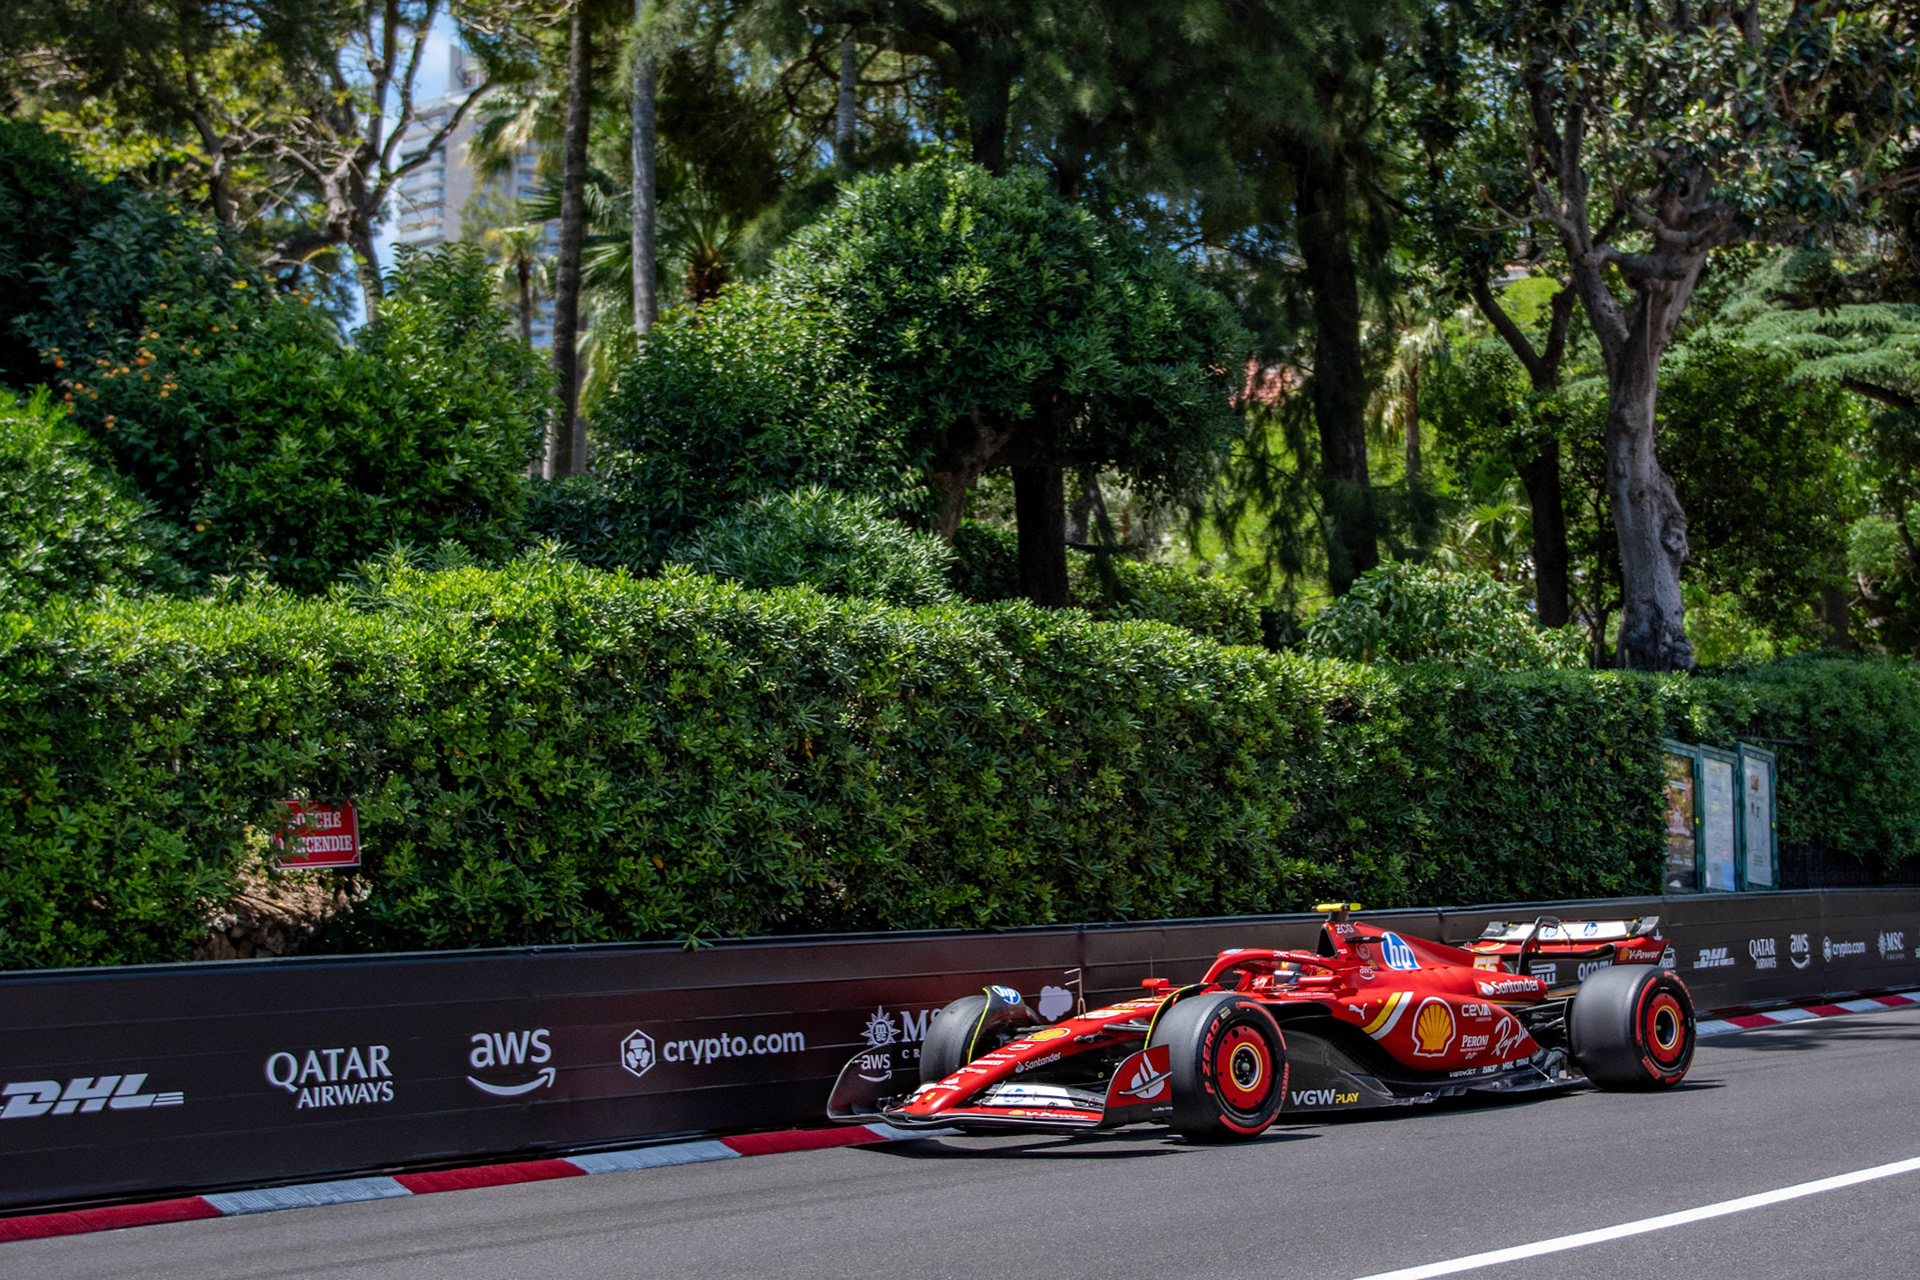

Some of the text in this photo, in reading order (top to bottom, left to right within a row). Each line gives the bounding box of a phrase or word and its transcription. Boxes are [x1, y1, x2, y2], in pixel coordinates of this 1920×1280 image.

[1383, 931, 1414, 970] hp
[1749, 938, 1775, 960] QATAR
[1790, 933, 1808, 953] aws
[1886, 932, 1904, 950] MSC
[1629, 949, 1660, 960] V-Power
[1698, 947, 1731, 969] DHL
[1491, 978, 1539, 994] Santander
[470, 1028, 552, 1068] aws
[663, 1031, 805, 1064] crypto.com
[1203, 1019, 1220, 1077] ZERO
[1462, 1035, 1489, 1047] PERONI
[265, 1045, 393, 1093] QATAR
[861, 1053, 891, 1070] aws
[1025, 1052, 1061, 1071] Santander
[0, 1073, 157, 1119] DHL
[297, 1081, 394, 1109] AIRWAYS
[1291, 1089, 1359, 1105] VGW PLAY
